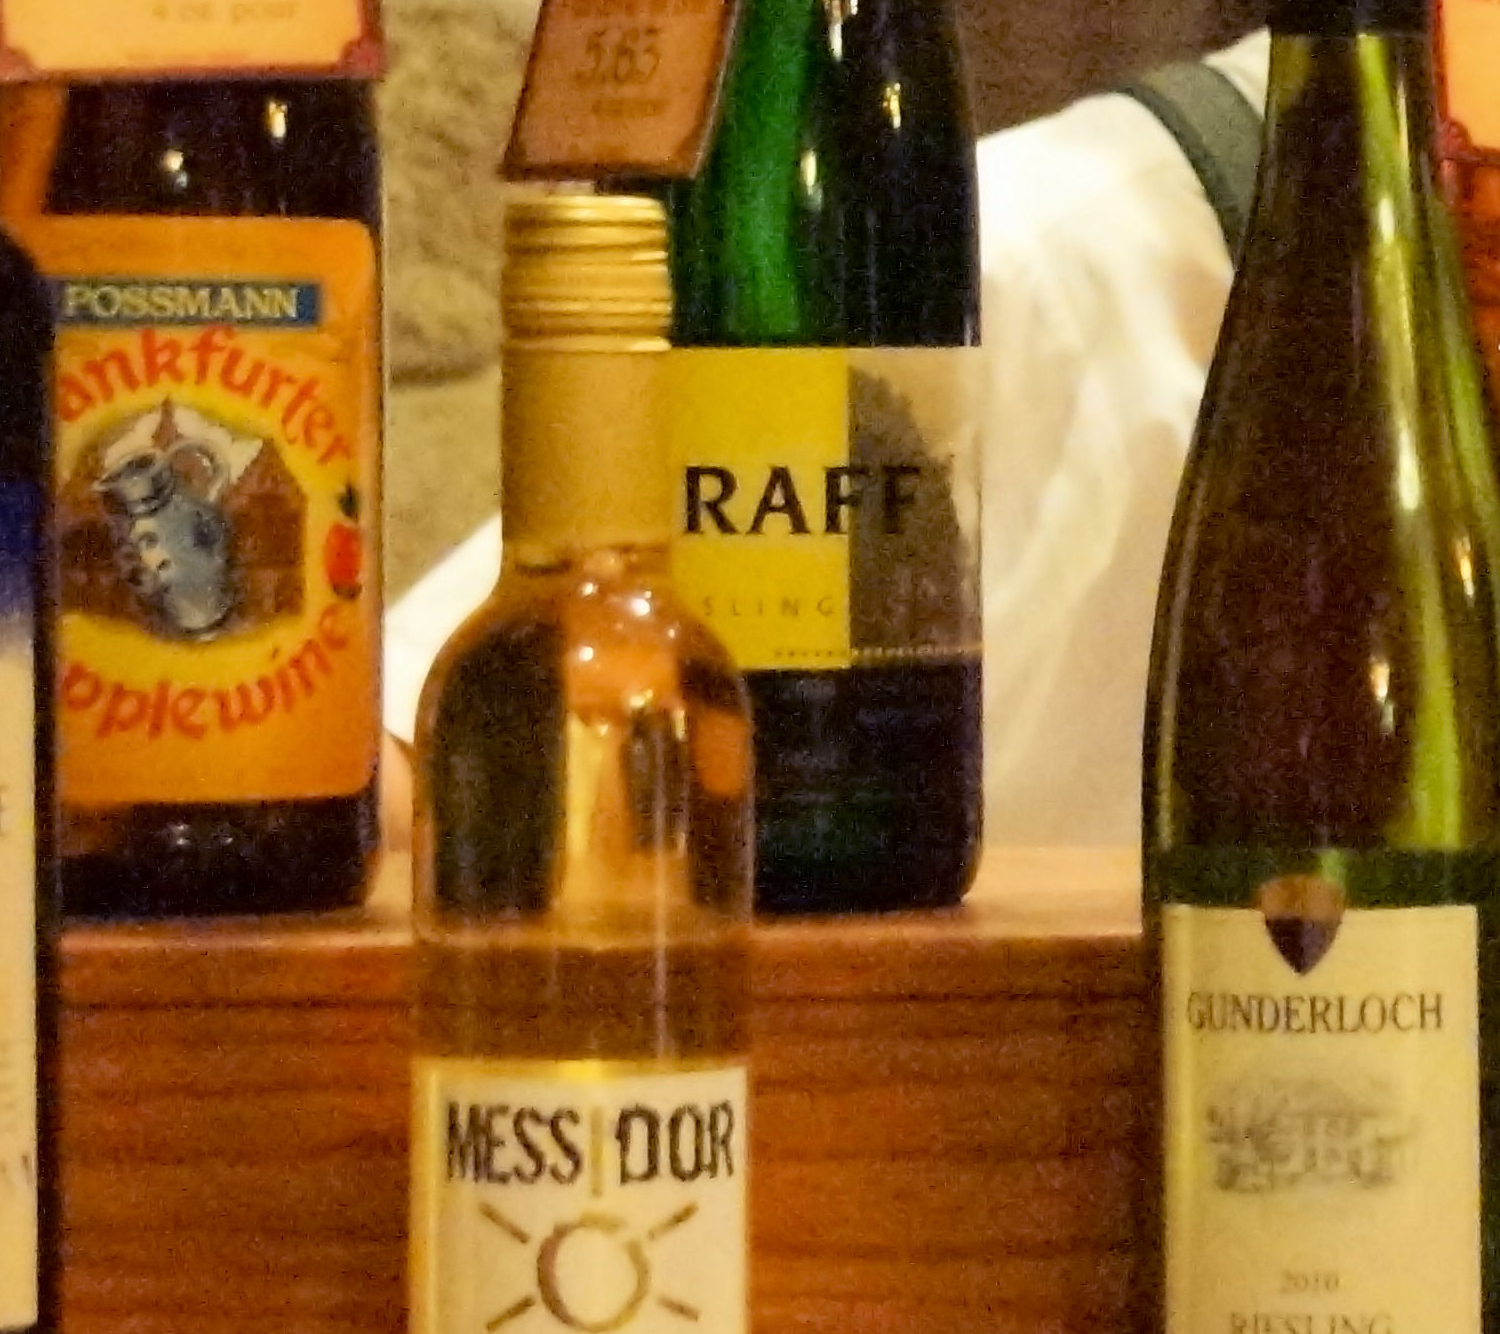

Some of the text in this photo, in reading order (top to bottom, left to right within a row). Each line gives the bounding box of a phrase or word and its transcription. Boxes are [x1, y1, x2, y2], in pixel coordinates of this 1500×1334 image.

[62, 282, 300, 323] POSSMANN
[56, 324, 360, 467] ankfurter
[682, 464, 922, 536] RAFF
[703, 595, 837, 618] SLING
[62, 602, 349, 740] pplewine
[1184, 991, 1444, 1035] GUNDERLOCH
